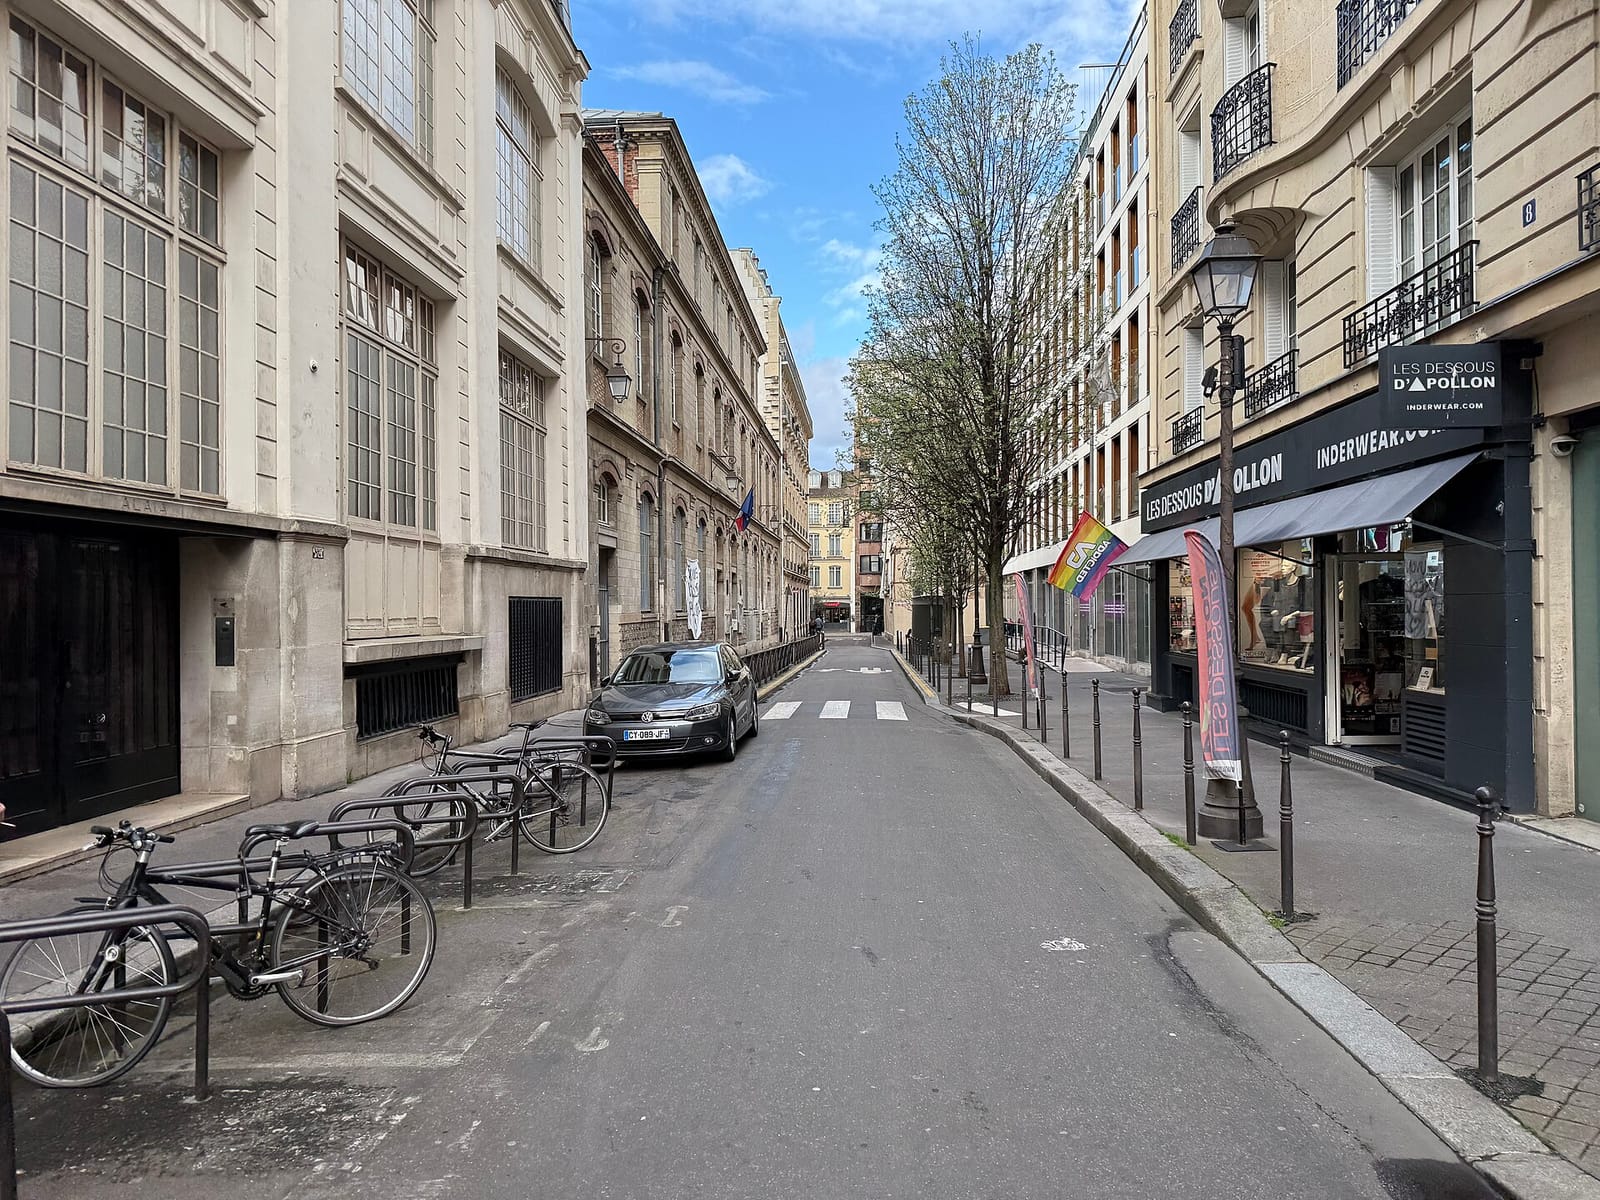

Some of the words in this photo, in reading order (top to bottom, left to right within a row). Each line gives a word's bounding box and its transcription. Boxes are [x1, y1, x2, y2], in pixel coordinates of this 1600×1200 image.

[1525, 203, 1533, 223] 8
[1393, 363, 1420, 375] LES
[1425, 361, 1495, 374] DESSOUS
[1406, 403, 1483, 411] INDERWEAR.COM
[1146, 499, 1160, 521] LES
[1161, 483, 1202, 519] DESSOUS
